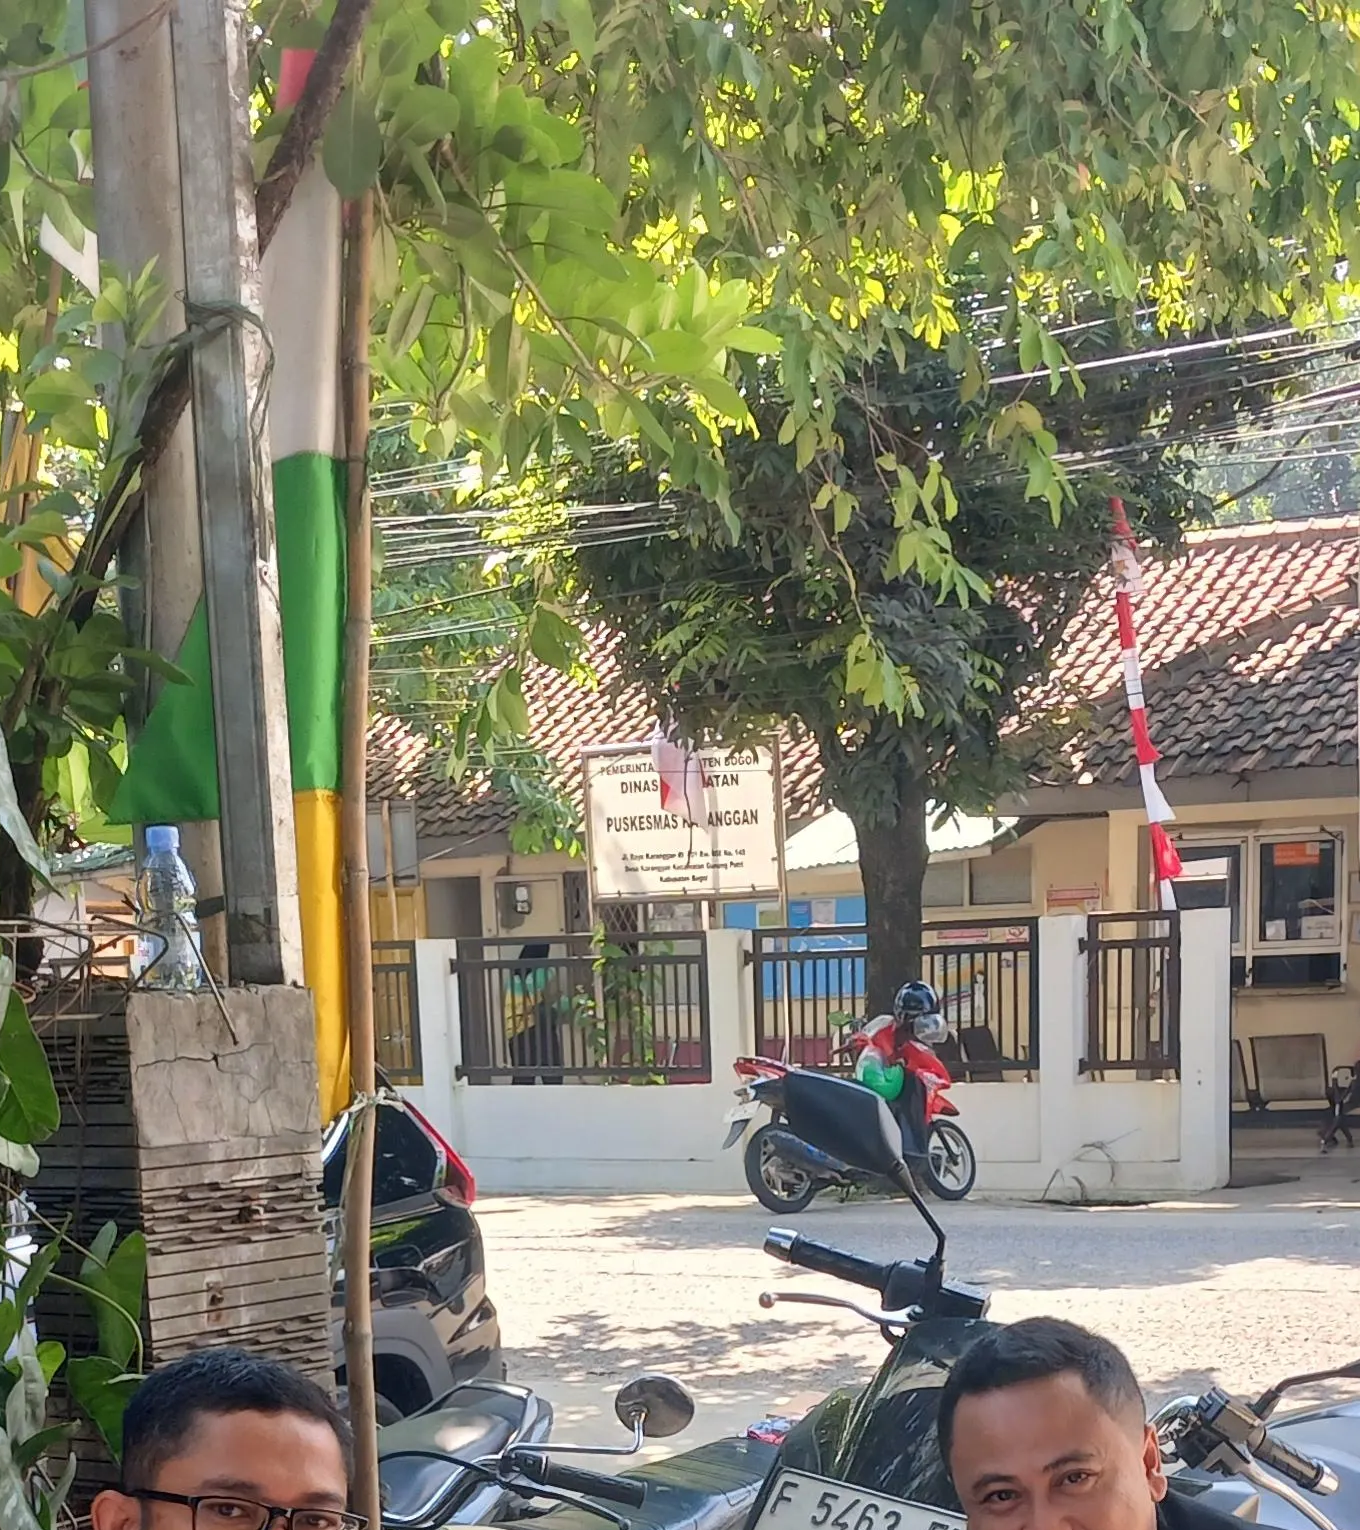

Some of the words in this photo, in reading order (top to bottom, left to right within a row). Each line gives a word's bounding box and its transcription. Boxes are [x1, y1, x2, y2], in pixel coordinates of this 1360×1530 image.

[600, 763, 654, 776] PEMERINTA
[621, 779, 659, 794] DINAS
[606, 814, 678, 833] PUSKESMAS
[683, 809, 758, 829] KANGGAN
[770, 1481, 799, 1515] F
